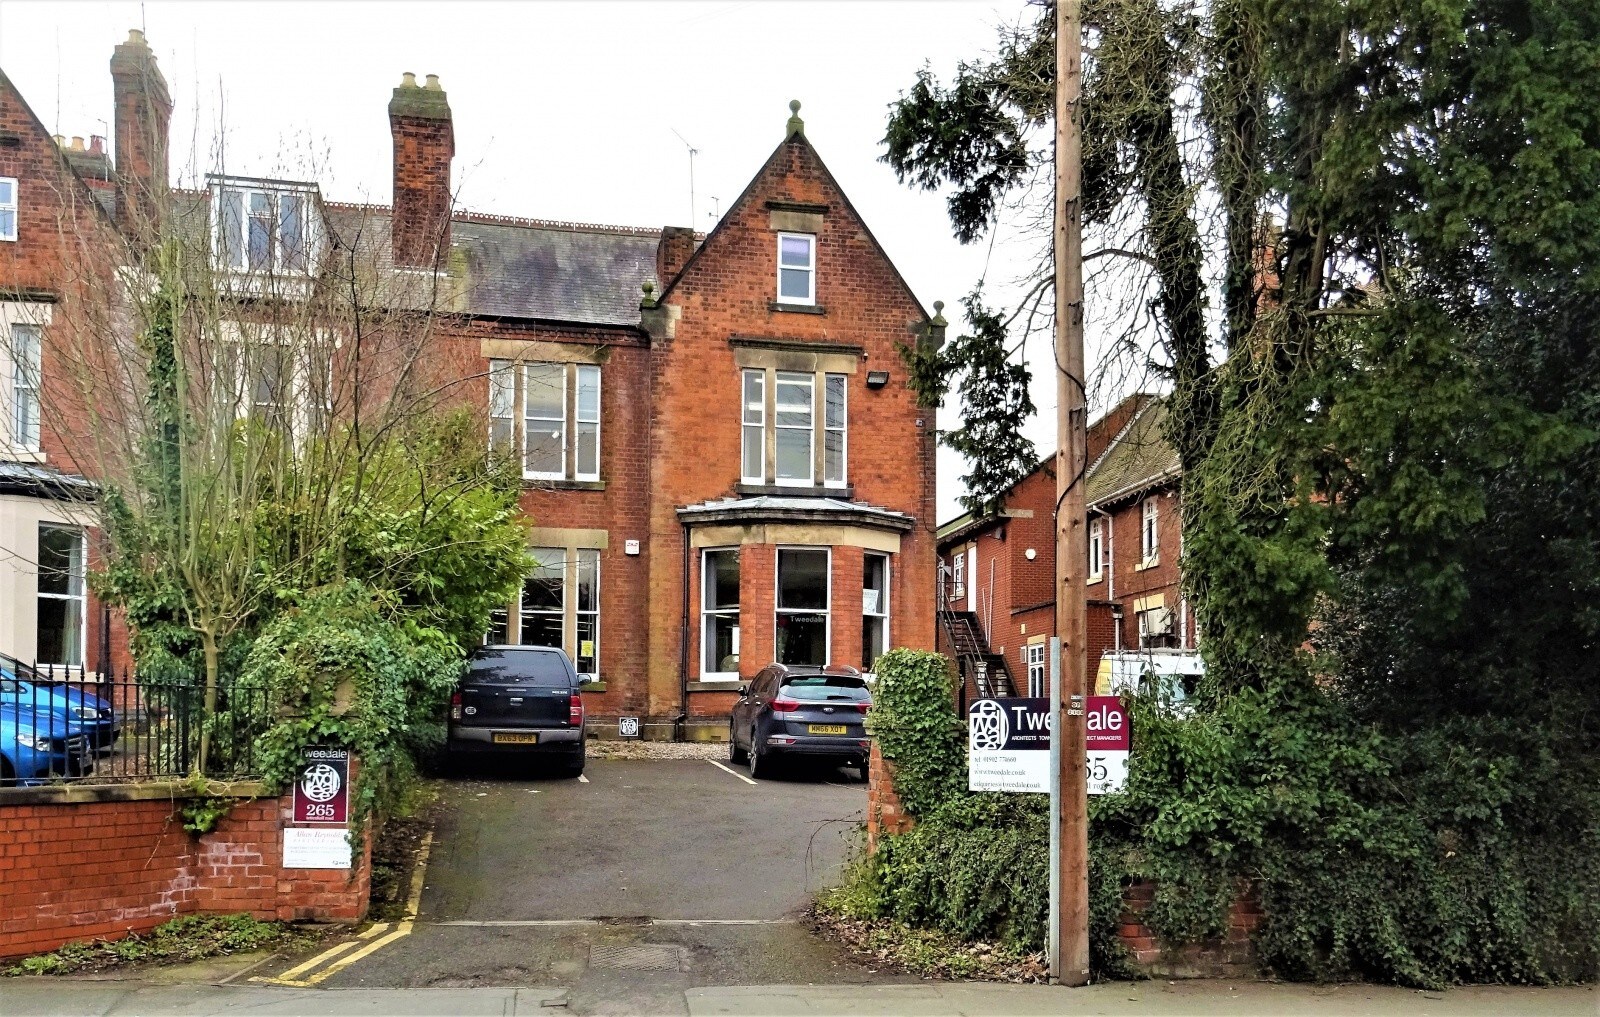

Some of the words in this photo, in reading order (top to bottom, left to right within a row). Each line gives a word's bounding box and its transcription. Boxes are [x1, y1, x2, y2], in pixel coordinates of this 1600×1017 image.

[790, 615, 824, 623] Tweedale
[1011, 705, 1122, 730] Twale
[306, 804, 335, 816] 265
